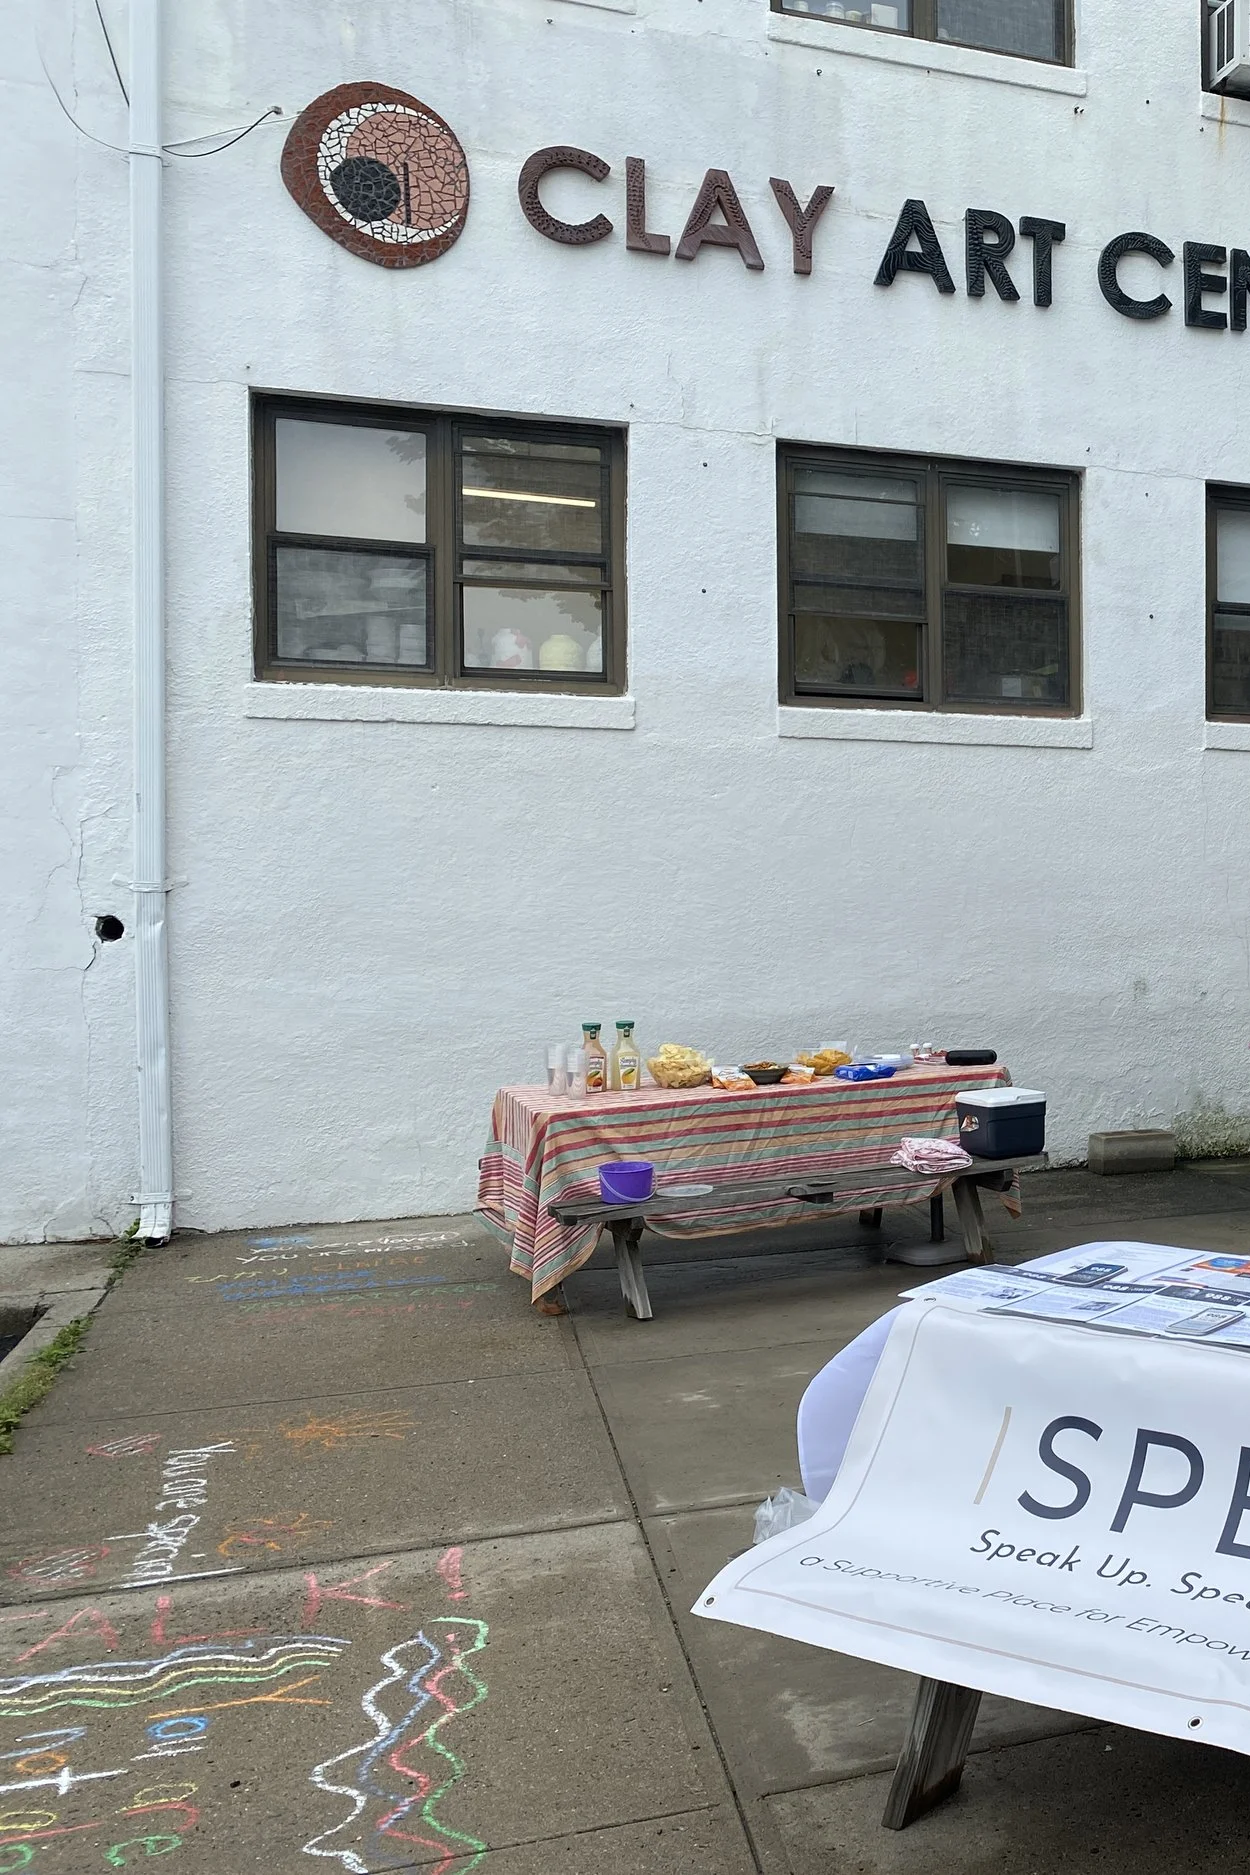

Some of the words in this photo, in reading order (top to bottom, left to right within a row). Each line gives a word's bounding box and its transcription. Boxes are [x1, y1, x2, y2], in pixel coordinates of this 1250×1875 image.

[518, 145, 835, 275] CLAY
[873, 198, 1066, 307] ART
[799, 1555, 824, 1567] a
[824, 1558, 981, 1595] Supportive
[983, 1590, 1076, 1614] Place
[1074, 1607, 1127, 1625] for
[970, 1529, 1080, 1572] Speak
[1096, 1553, 1151, 1588] Up.
